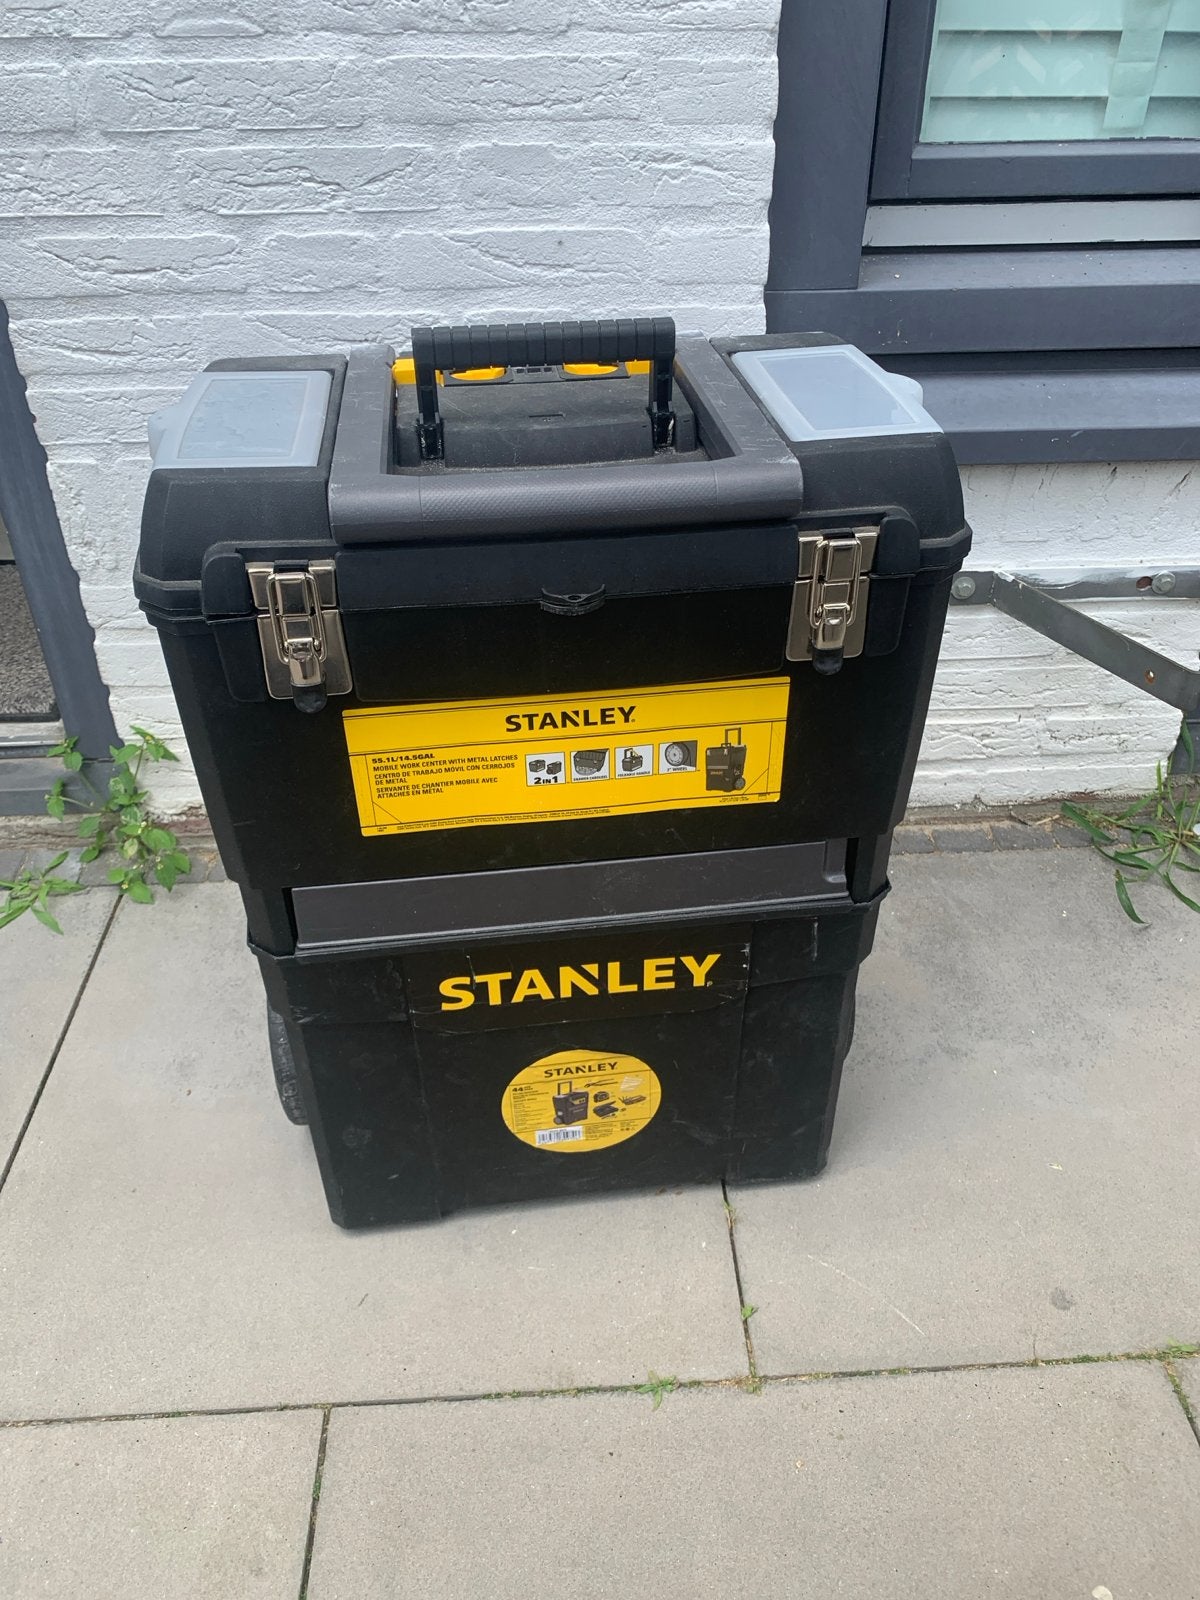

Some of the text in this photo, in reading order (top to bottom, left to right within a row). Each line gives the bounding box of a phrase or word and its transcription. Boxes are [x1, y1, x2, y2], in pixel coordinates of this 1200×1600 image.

[505, 705, 637, 733] STANLEY
[373, 764, 399, 772] MOBILE
[421, 759, 447, 767] CENTER
[447, 757, 466, 765] WITH
[489, 754, 519, 762] LATCHES
[374, 771, 401, 780] CENTRO
[412, 767, 443, 776] TRABAJO
[481, 762, 516, 770] CERROJOS
[376, 785, 410, 793] SERVANTE
[421, 780, 455, 789] CHANTIER
[385, 777, 408, 785] METAL
[377, 790, 411, 799] ATTACHES
[438, 953, 722, 1011] STANLEY
[543, 1061, 619, 1079] STANLEY
